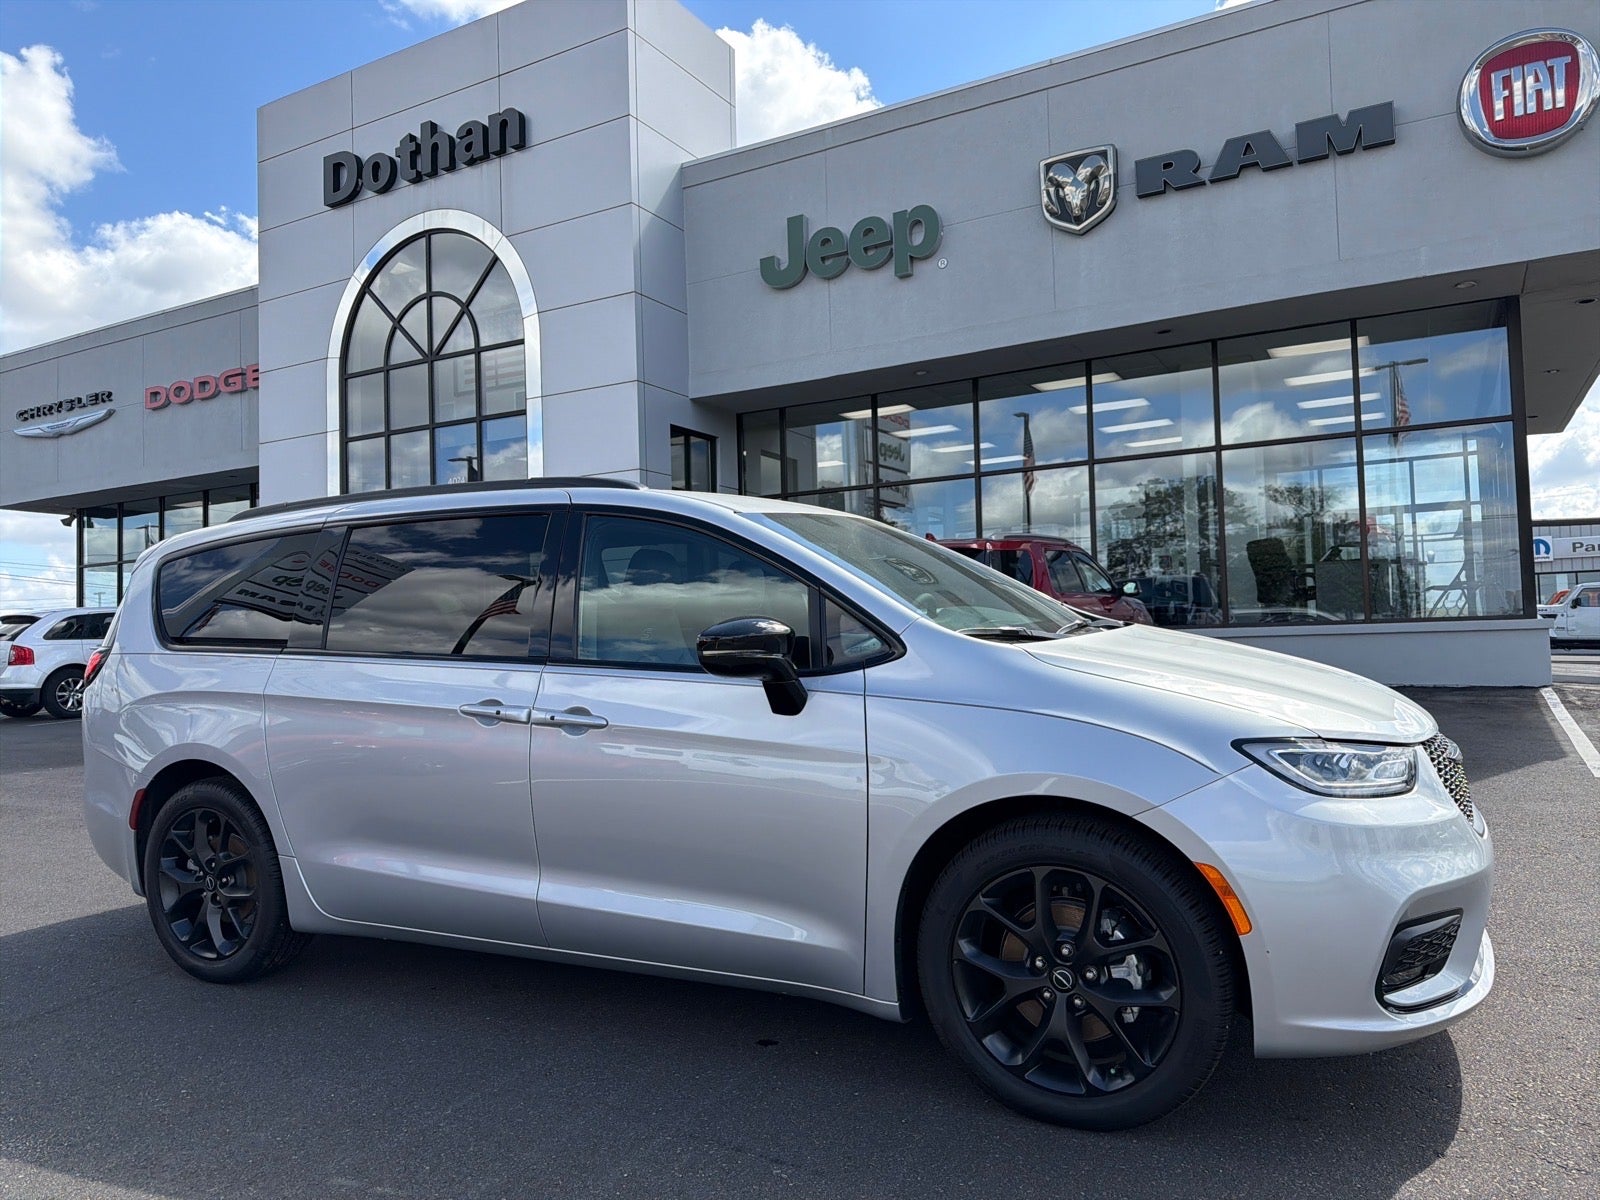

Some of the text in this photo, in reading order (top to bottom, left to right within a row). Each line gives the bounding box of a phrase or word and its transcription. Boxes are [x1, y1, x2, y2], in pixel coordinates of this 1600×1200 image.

[1491, 55, 1572, 122] FIAT
[323, 107, 526, 208] Dothan
[1134, 100, 1396, 199] RAM
[759, 204, 944, 290] Jeep
[16, 390, 113, 422] CHRYSLER
[144, 363, 259, 411] DODGE
